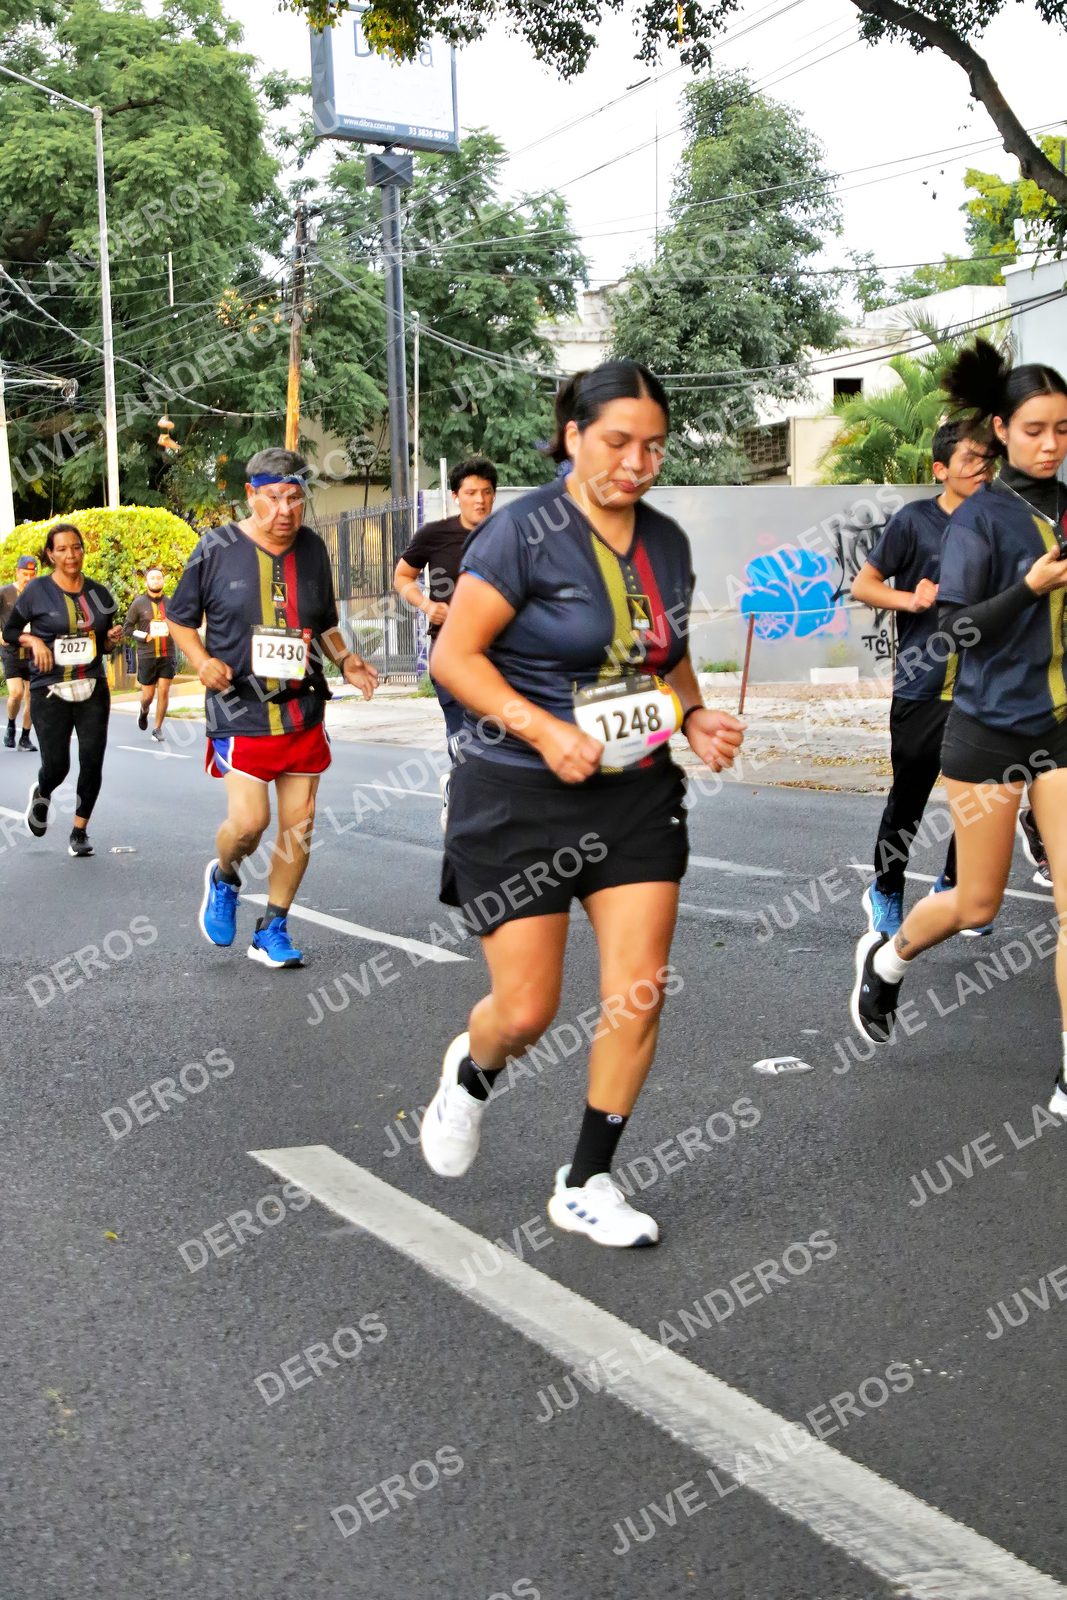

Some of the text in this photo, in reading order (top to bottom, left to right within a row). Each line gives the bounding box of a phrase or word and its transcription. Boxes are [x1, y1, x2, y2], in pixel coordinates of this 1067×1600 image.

[60, 641, 87, 653] 2027
[257, 642, 304, 661] 12430
[596, 703, 662, 742] 1248
